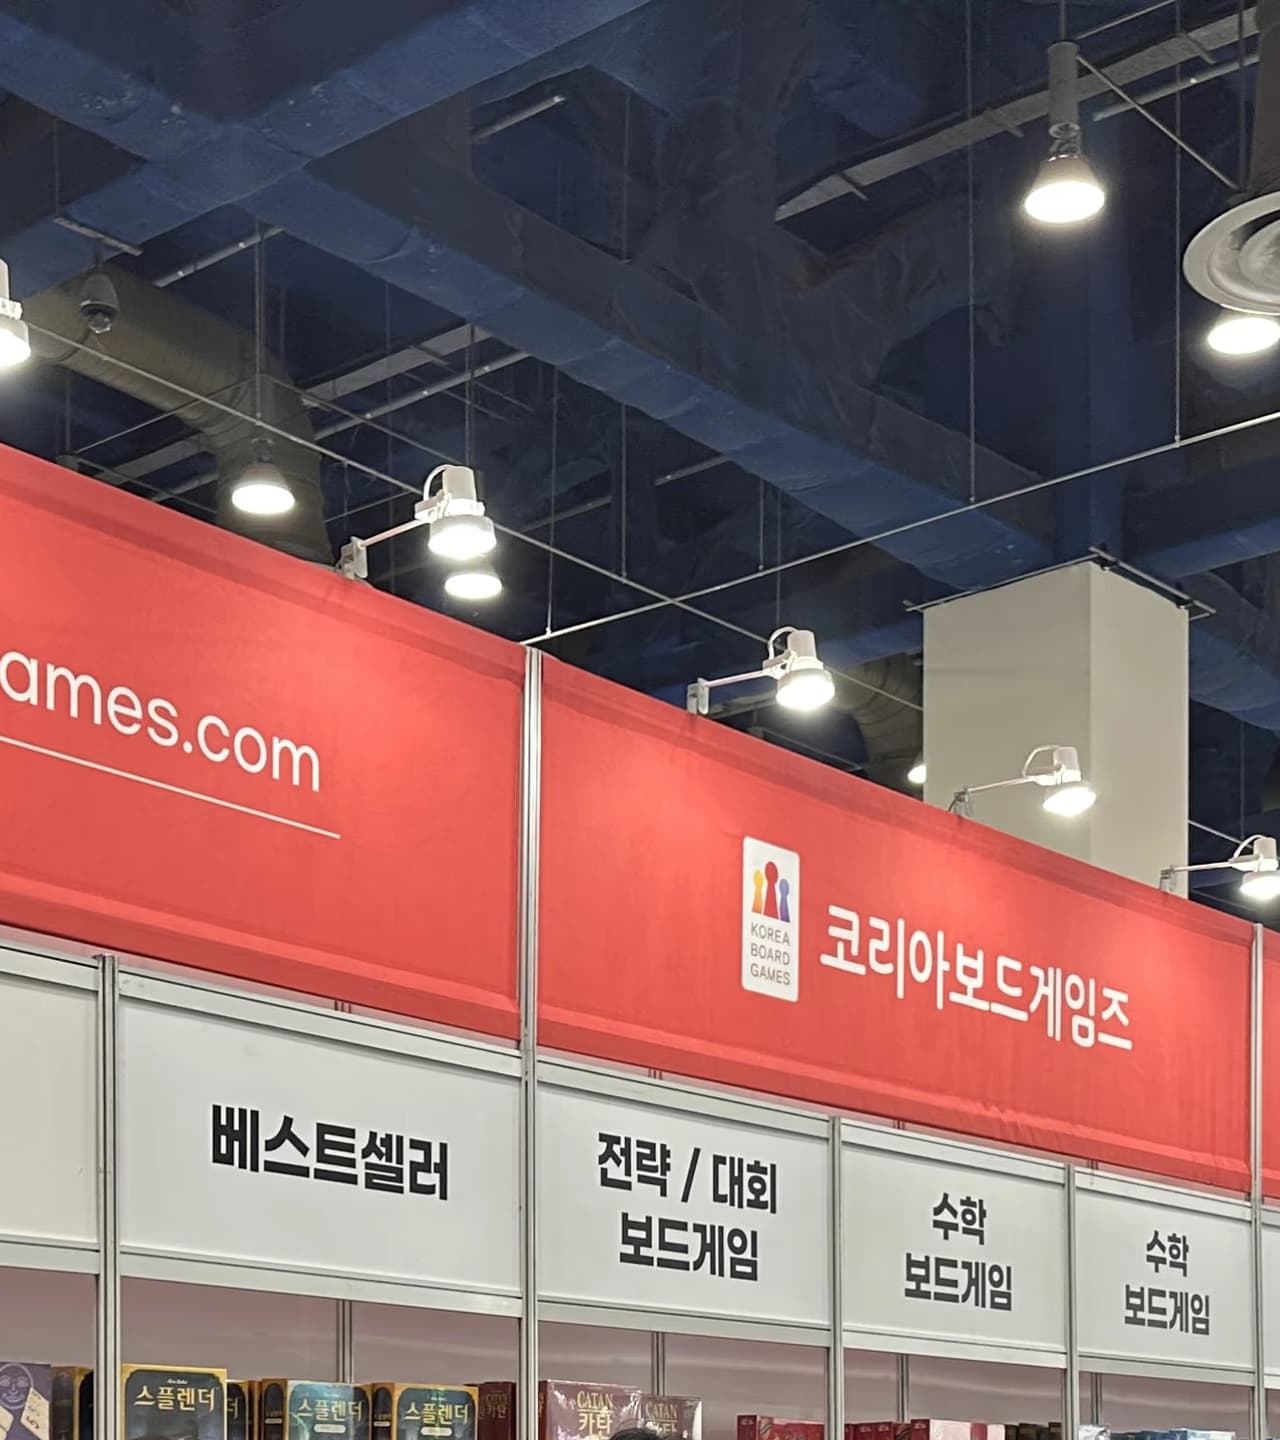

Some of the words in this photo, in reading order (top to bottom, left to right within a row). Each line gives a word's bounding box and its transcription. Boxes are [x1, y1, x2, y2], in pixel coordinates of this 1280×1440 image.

[750, 922, 791, 947] KOREA
[750, 943, 791, 967] BOARD
[750, 963, 791, 988] GAMES
[820, 904, 1134, 1051] 코리아보드게임즈
[211, 1104, 449, 1201] 베스트셀러
[597, 1132, 671, 1197] 전략
[681, 1147, 701, 1204] /
[712, 1153, 778, 1214] 대회
[932, 1192, 987, 1246] 수학
[619, 1212, 759, 1281] 보드게임
[1145, 1229, 1190, 1278] 수학
[904, 1253, 1013, 1312] 보드게임
[1124, 1284, 1210, 1337] 보드게임
[135, 1386, 216, 1412] 스플렌더
[296, 1398, 363, 1423] 스플렌더
[404, 1403, 469, 1426] 스플렌더
